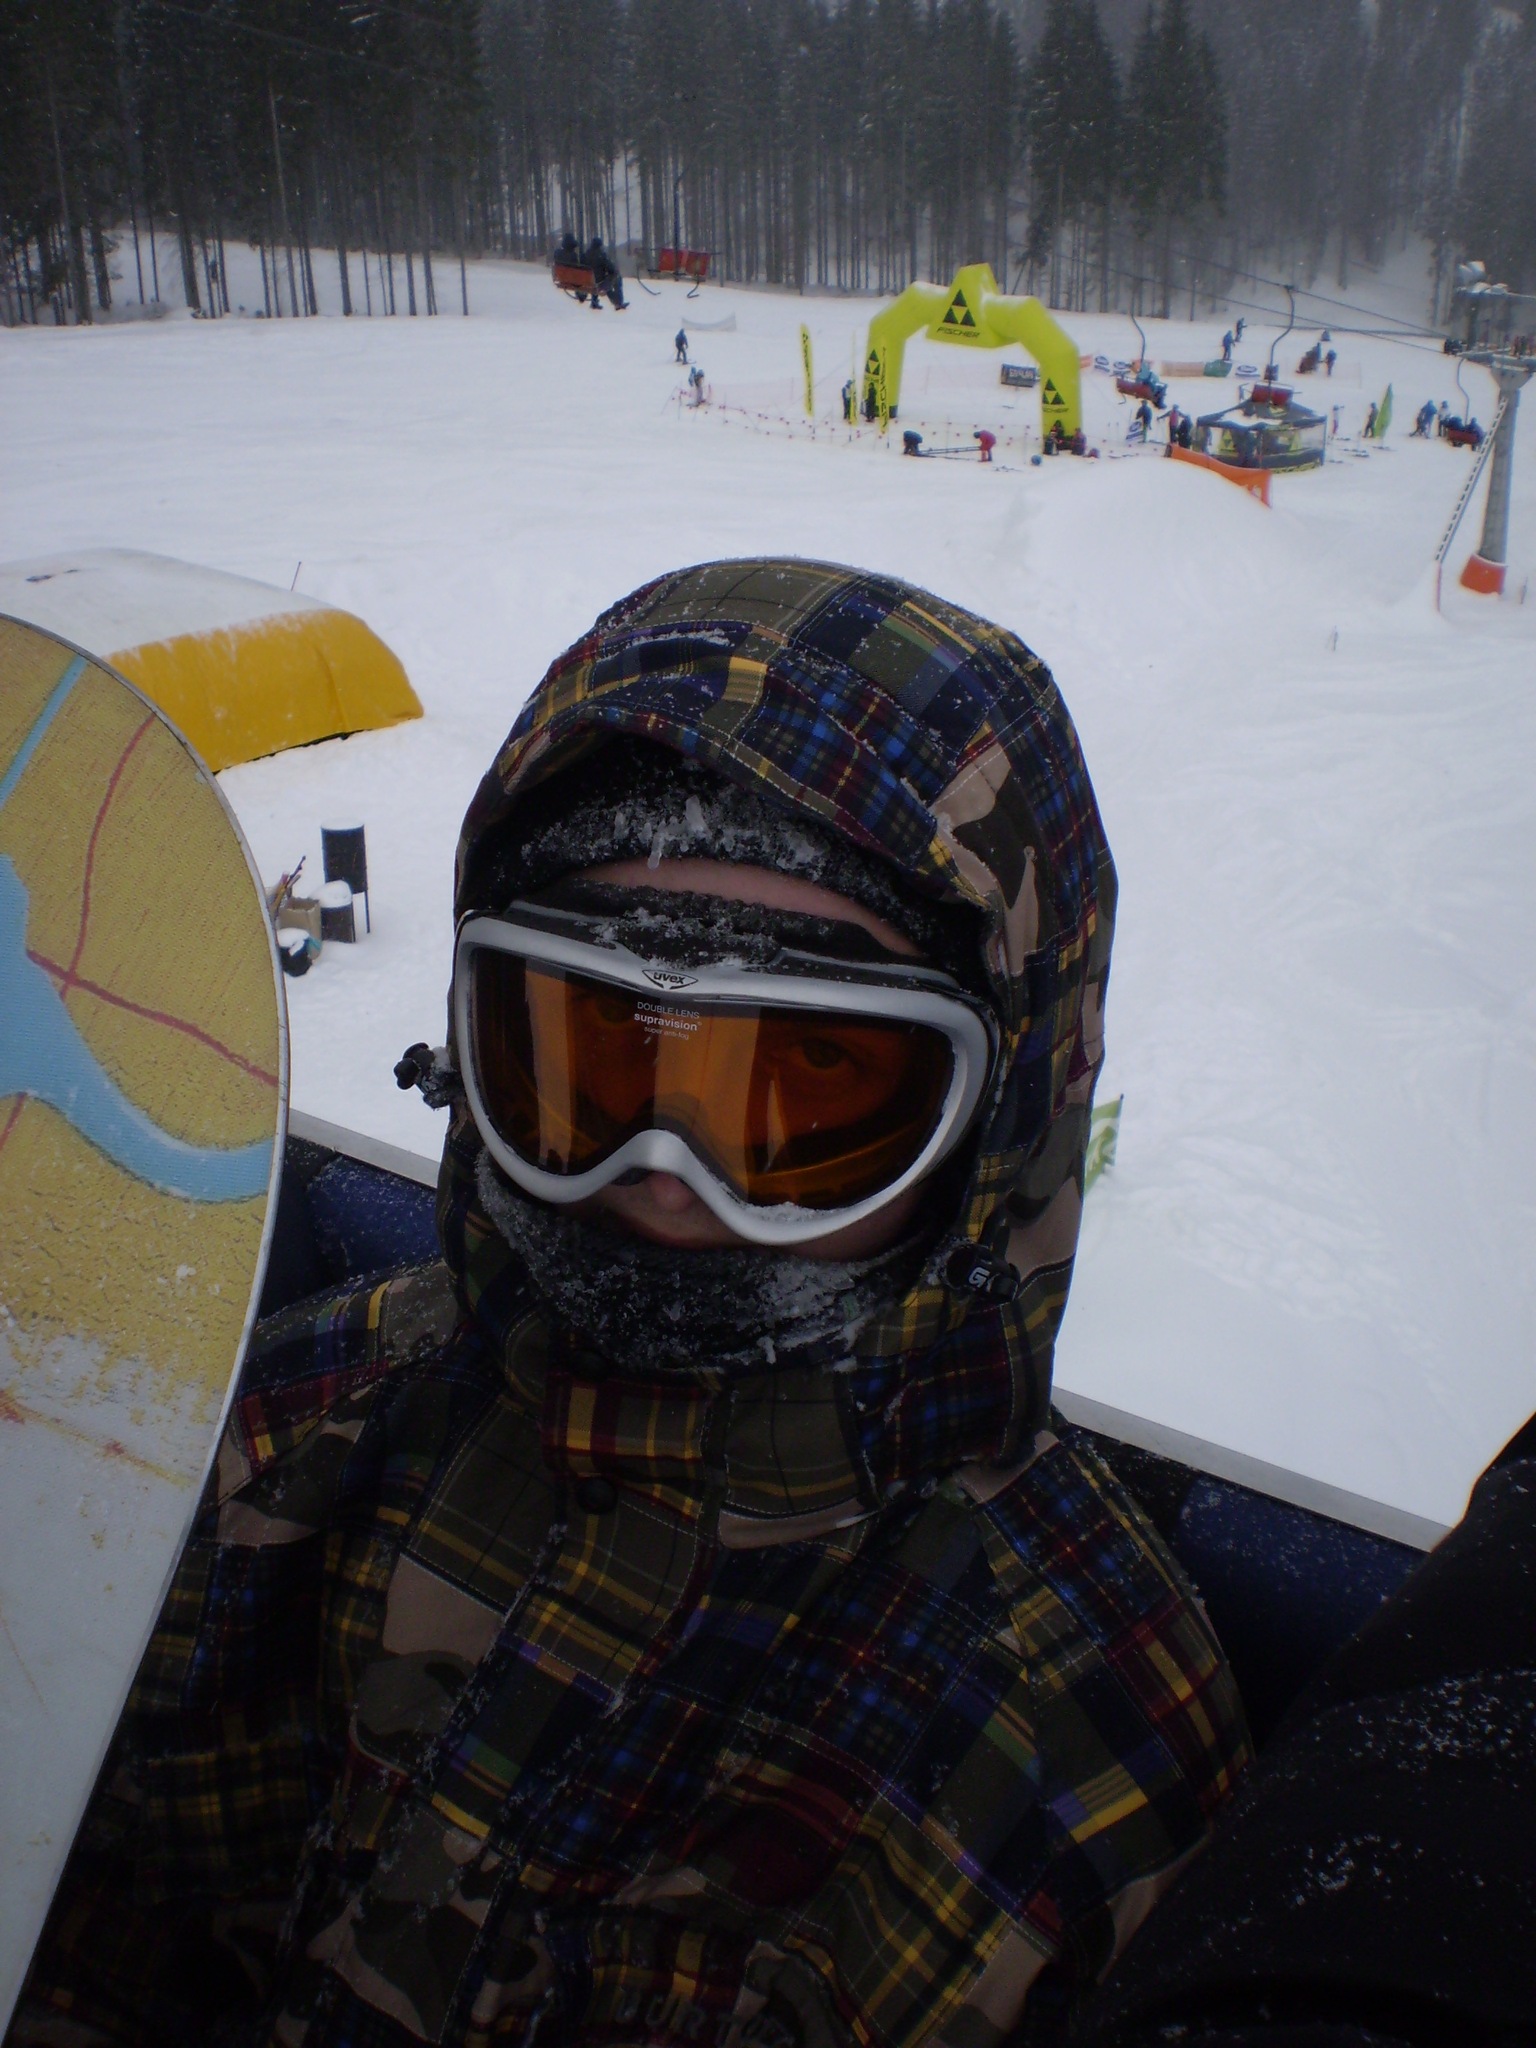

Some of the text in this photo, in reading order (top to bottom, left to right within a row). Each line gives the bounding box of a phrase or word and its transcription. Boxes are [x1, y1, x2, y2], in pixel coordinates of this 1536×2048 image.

[937, 326, 980, 338] FISCHER
[653, 972, 686, 984] uvex
[637, 1001, 700, 1019] DOUBLE LENS
[644, 1026, 663, 1035] super
